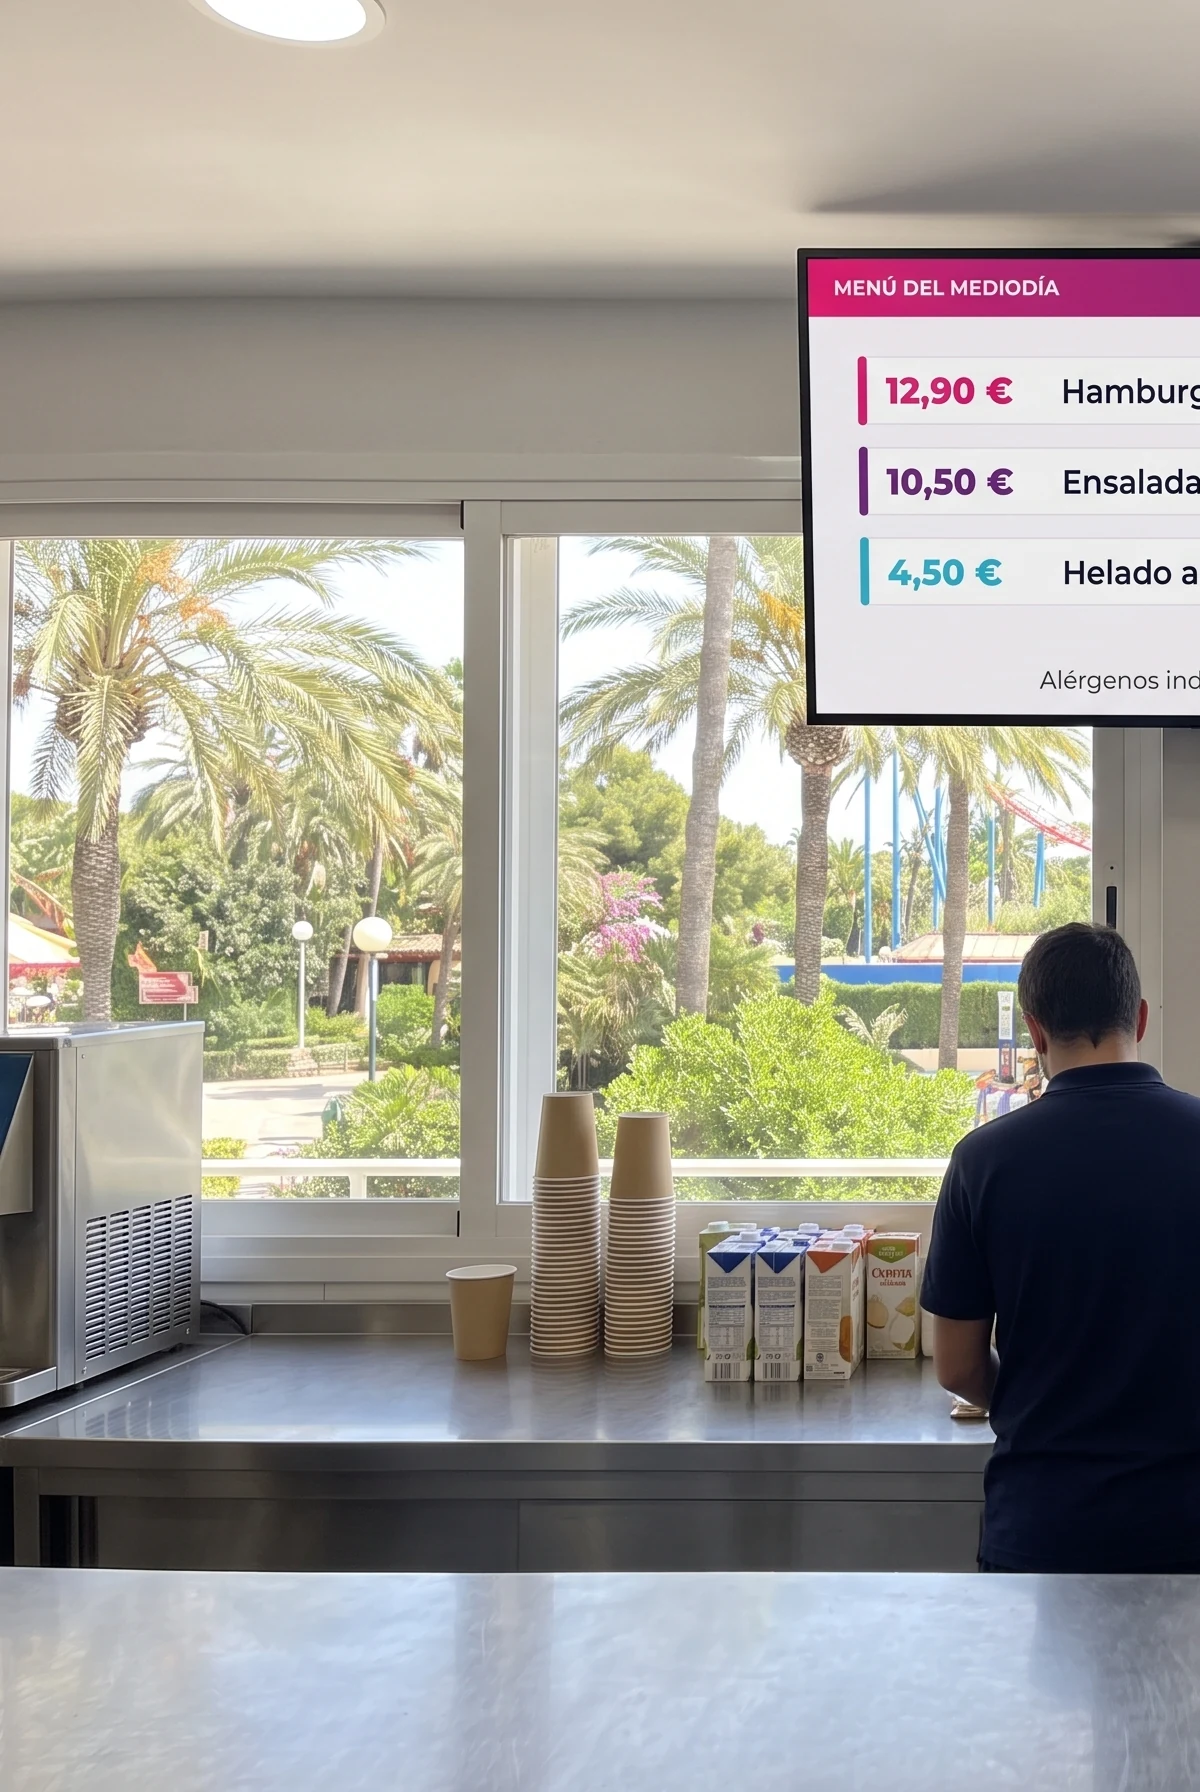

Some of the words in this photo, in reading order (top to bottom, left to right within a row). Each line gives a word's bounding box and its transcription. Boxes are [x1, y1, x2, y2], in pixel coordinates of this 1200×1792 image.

[834, 274, 896, 297] MENÚ
[903, 280, 944, 297] DEL
[950, 274, 1060, 297] MEDIODÍA
[886, 377, 975, 409] 12,90
[986, 377, 1013, 404] €
[886, 468, 976, 500] 10,50
[987, 468, 1013, 495] €
[1064, 468, 1200, 494] Ensalada
[888, 559, 964, 591] 4,50
[975, 559, 1002, 586] €
[1065, 559, 1172, 585] Helado
[1040, 670, 1159, 694] Alérgenos
